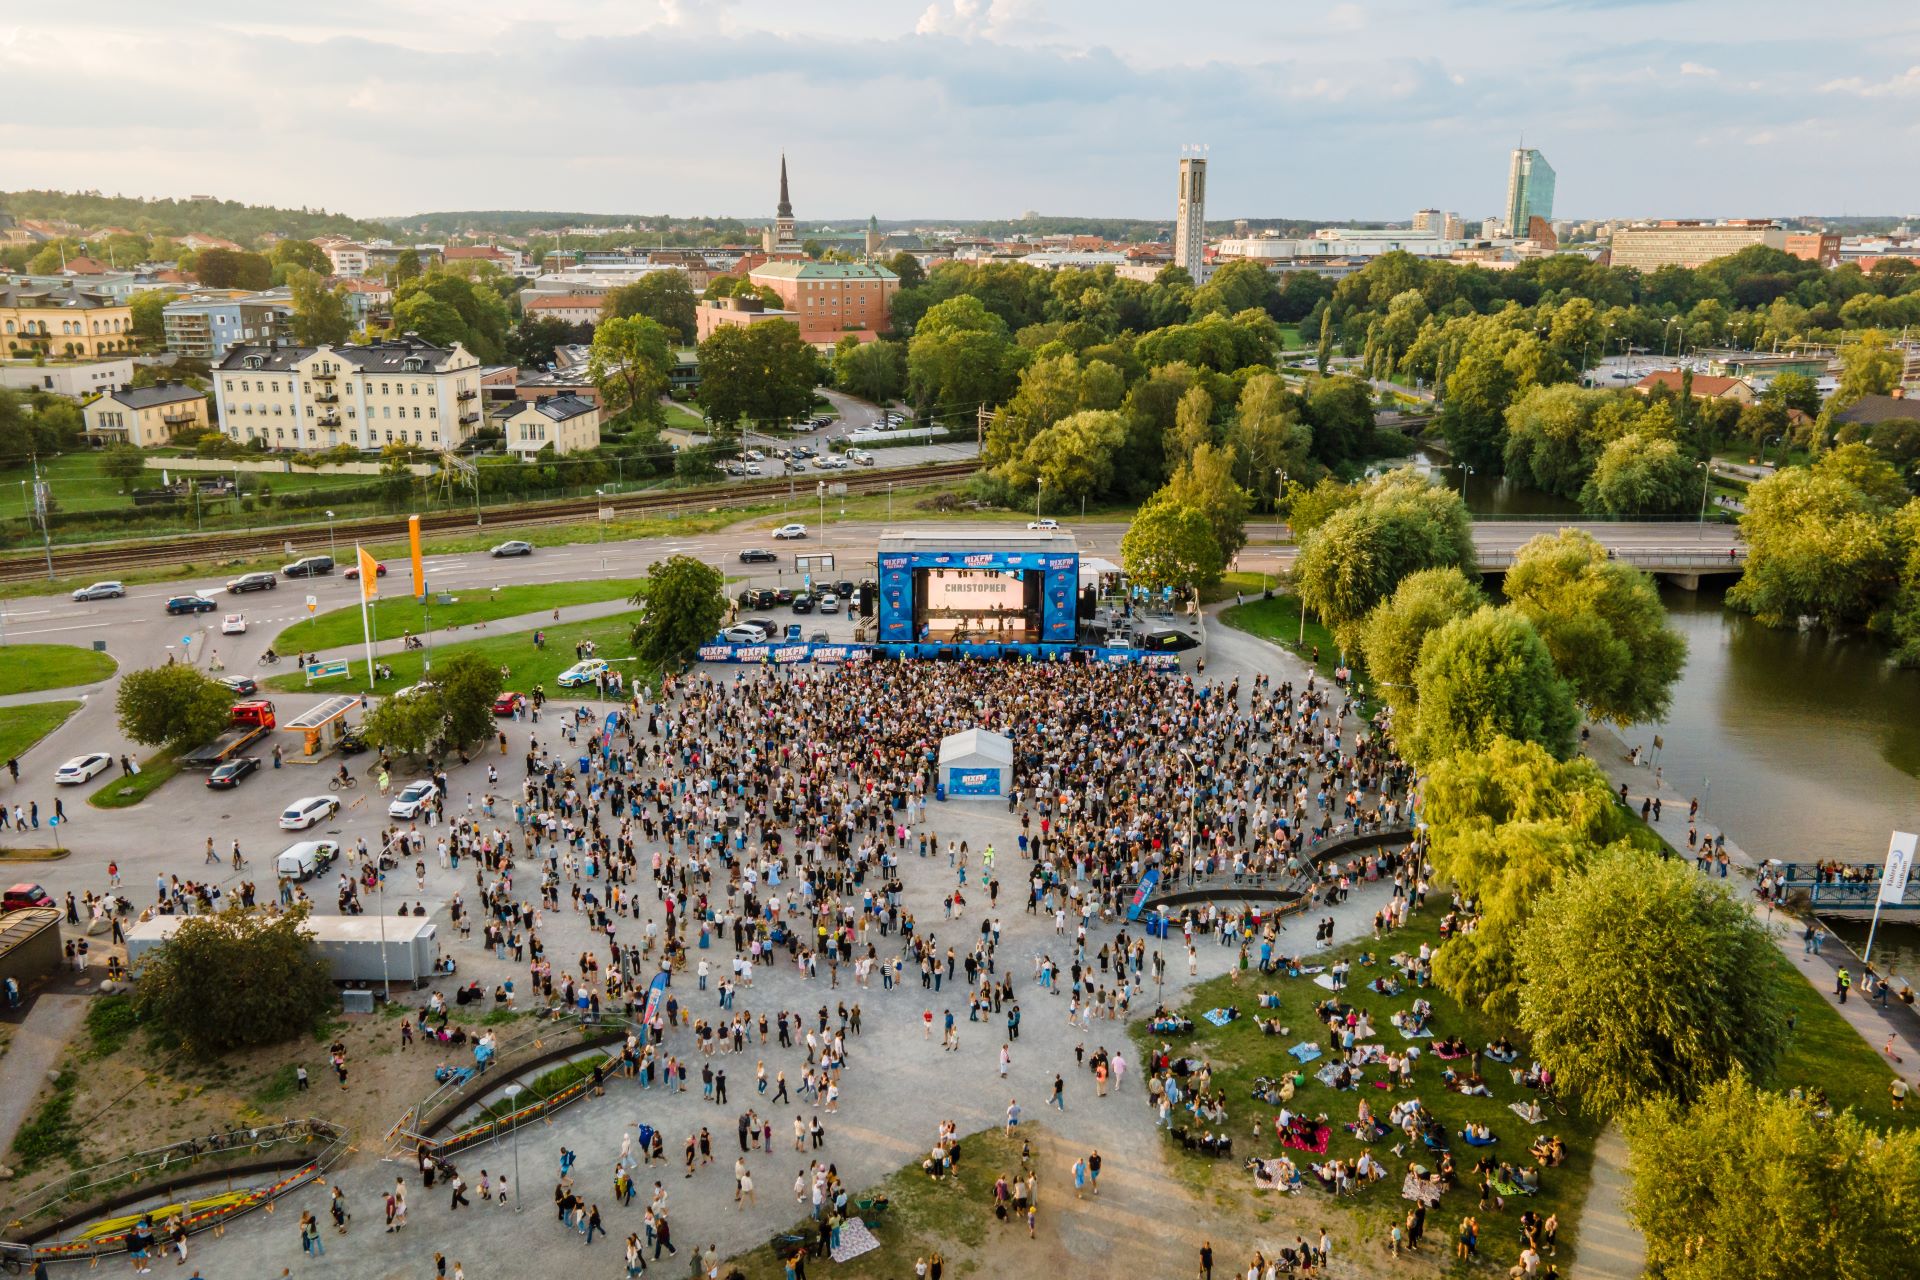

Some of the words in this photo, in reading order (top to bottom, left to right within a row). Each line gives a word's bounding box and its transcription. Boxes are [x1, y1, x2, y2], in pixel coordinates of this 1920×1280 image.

[964, 554, 993, 564] RIXFM
[944, 583, 1007, 593] CHRISTOPHER
[699, 646, 732, 656] RIXFM
[736, 646, 770, 658] RIXFM
[774, 645, 809, 658] RIXFM
[813, 647, 847, 658] RIXFM
